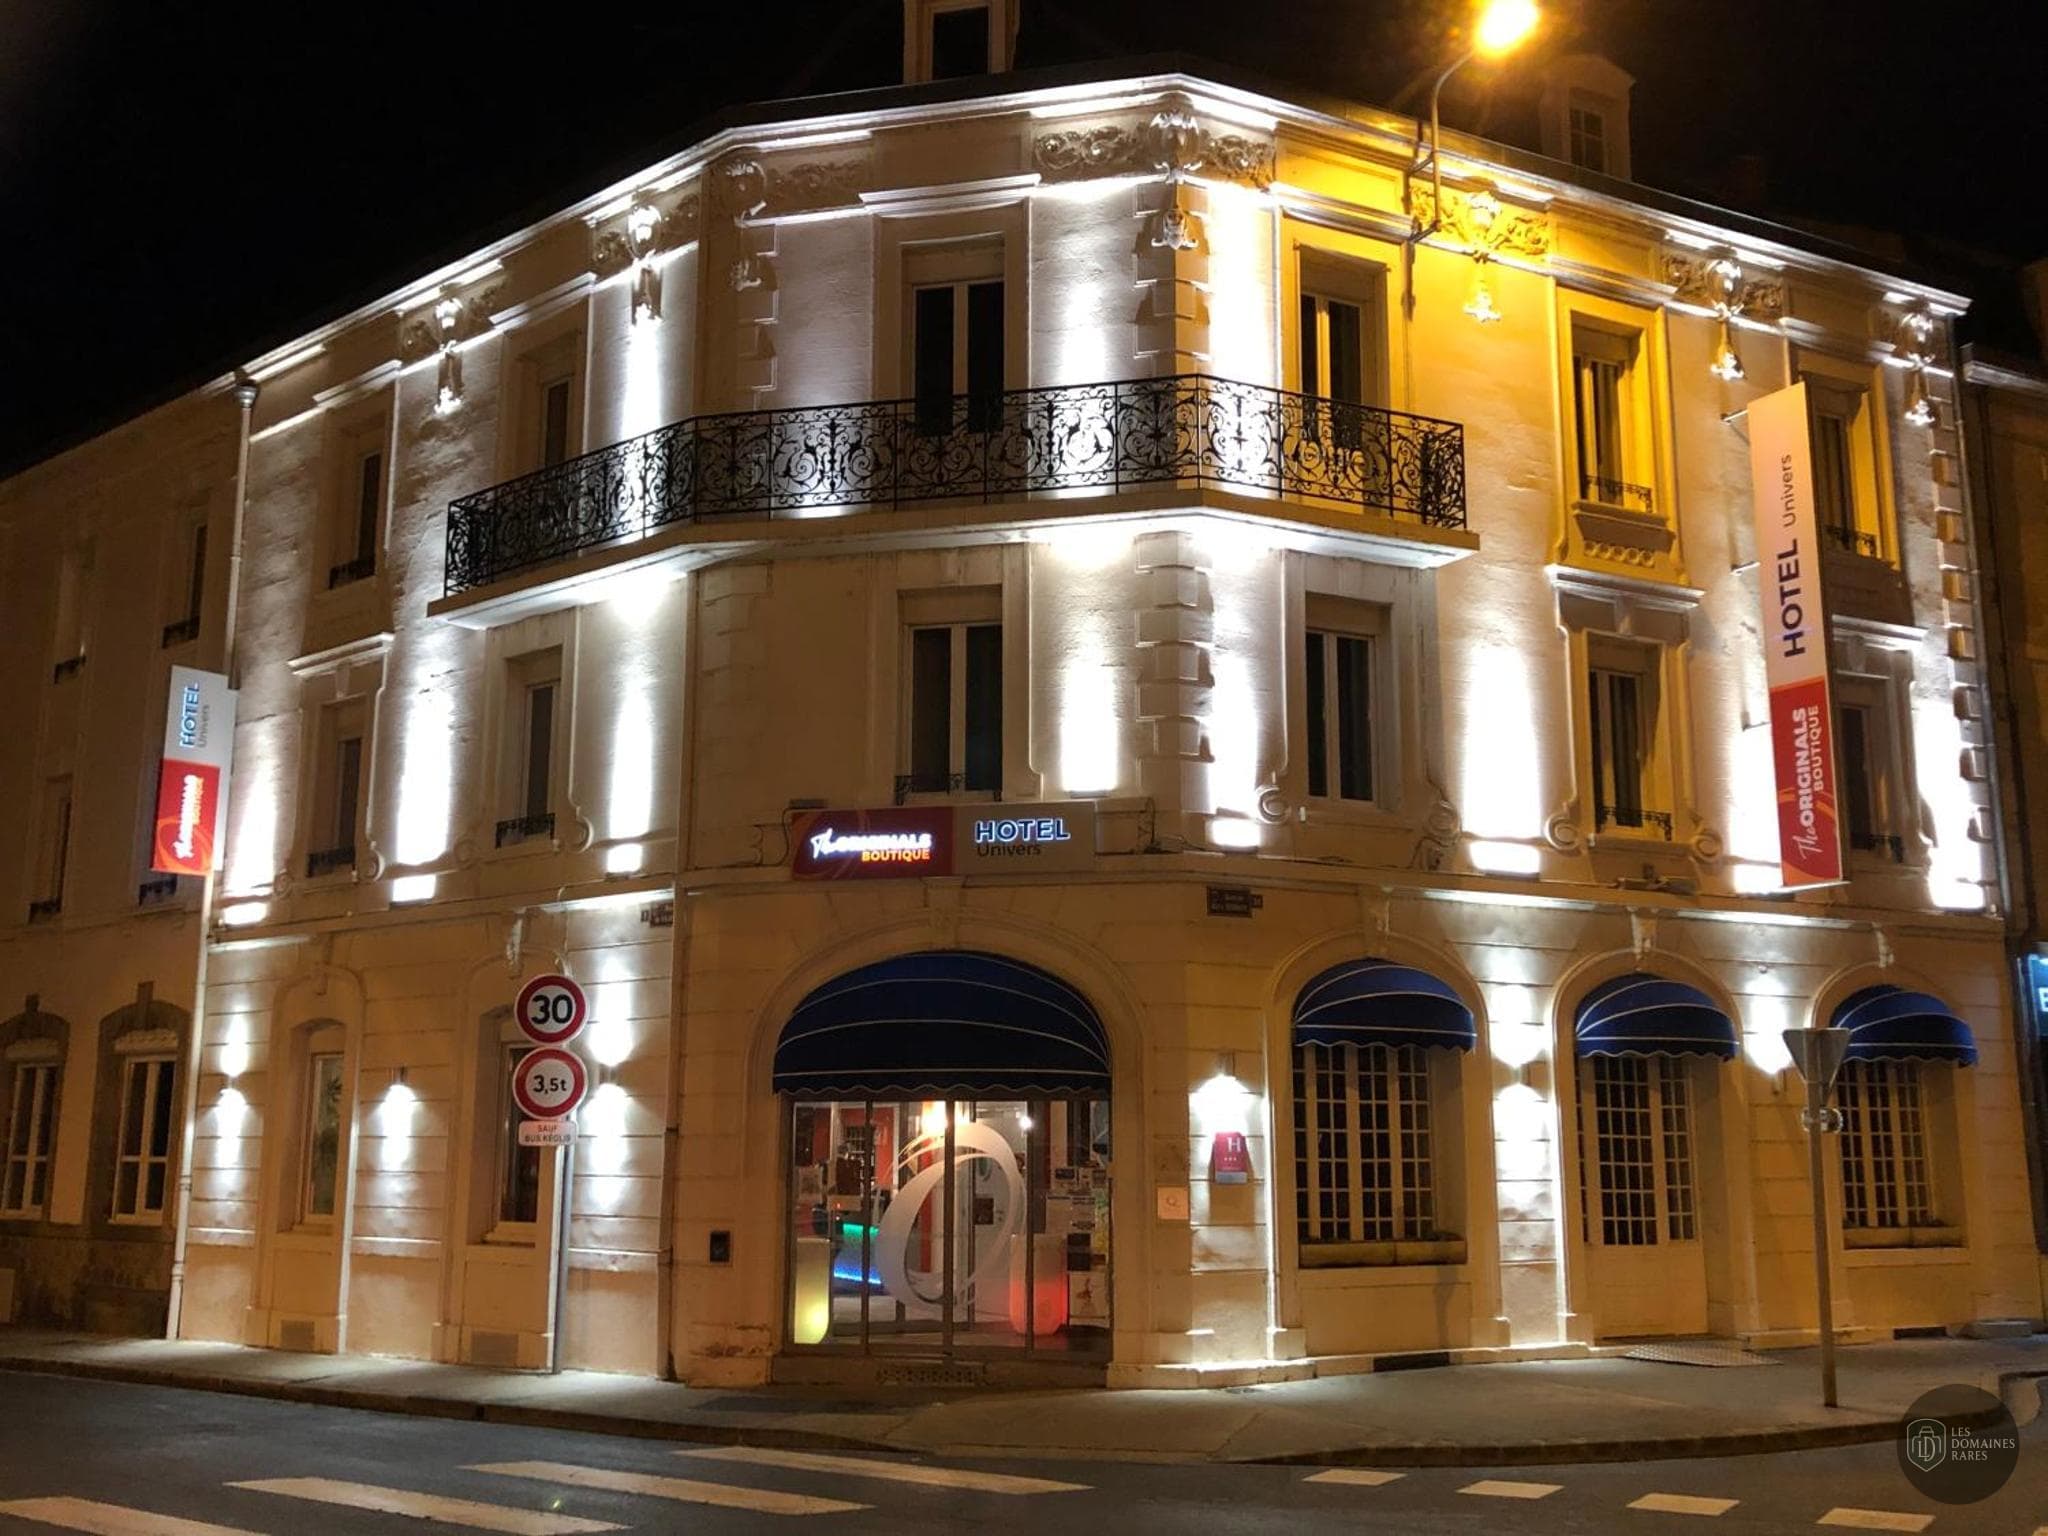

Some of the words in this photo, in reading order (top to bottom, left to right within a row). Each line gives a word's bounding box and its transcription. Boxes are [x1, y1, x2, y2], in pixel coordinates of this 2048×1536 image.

[1780, 453, 1797, 528] Univers
[1777, 538, 1806, 658] HOTEL
[179, 681, 200, 747] HOTEL
[1808, 704, 1824, 792] BOUTIQUE
[975, 818, 1071, 843] HOTEL
[861, 848, 931, 862] BOUTIQUE
[976, 843, 1041, 857] Univers
[531, 994, 573, 1025] 30
[533, 1074, 567, 1095] 3,5t
[1226, 1136, 1242, 1153] H
